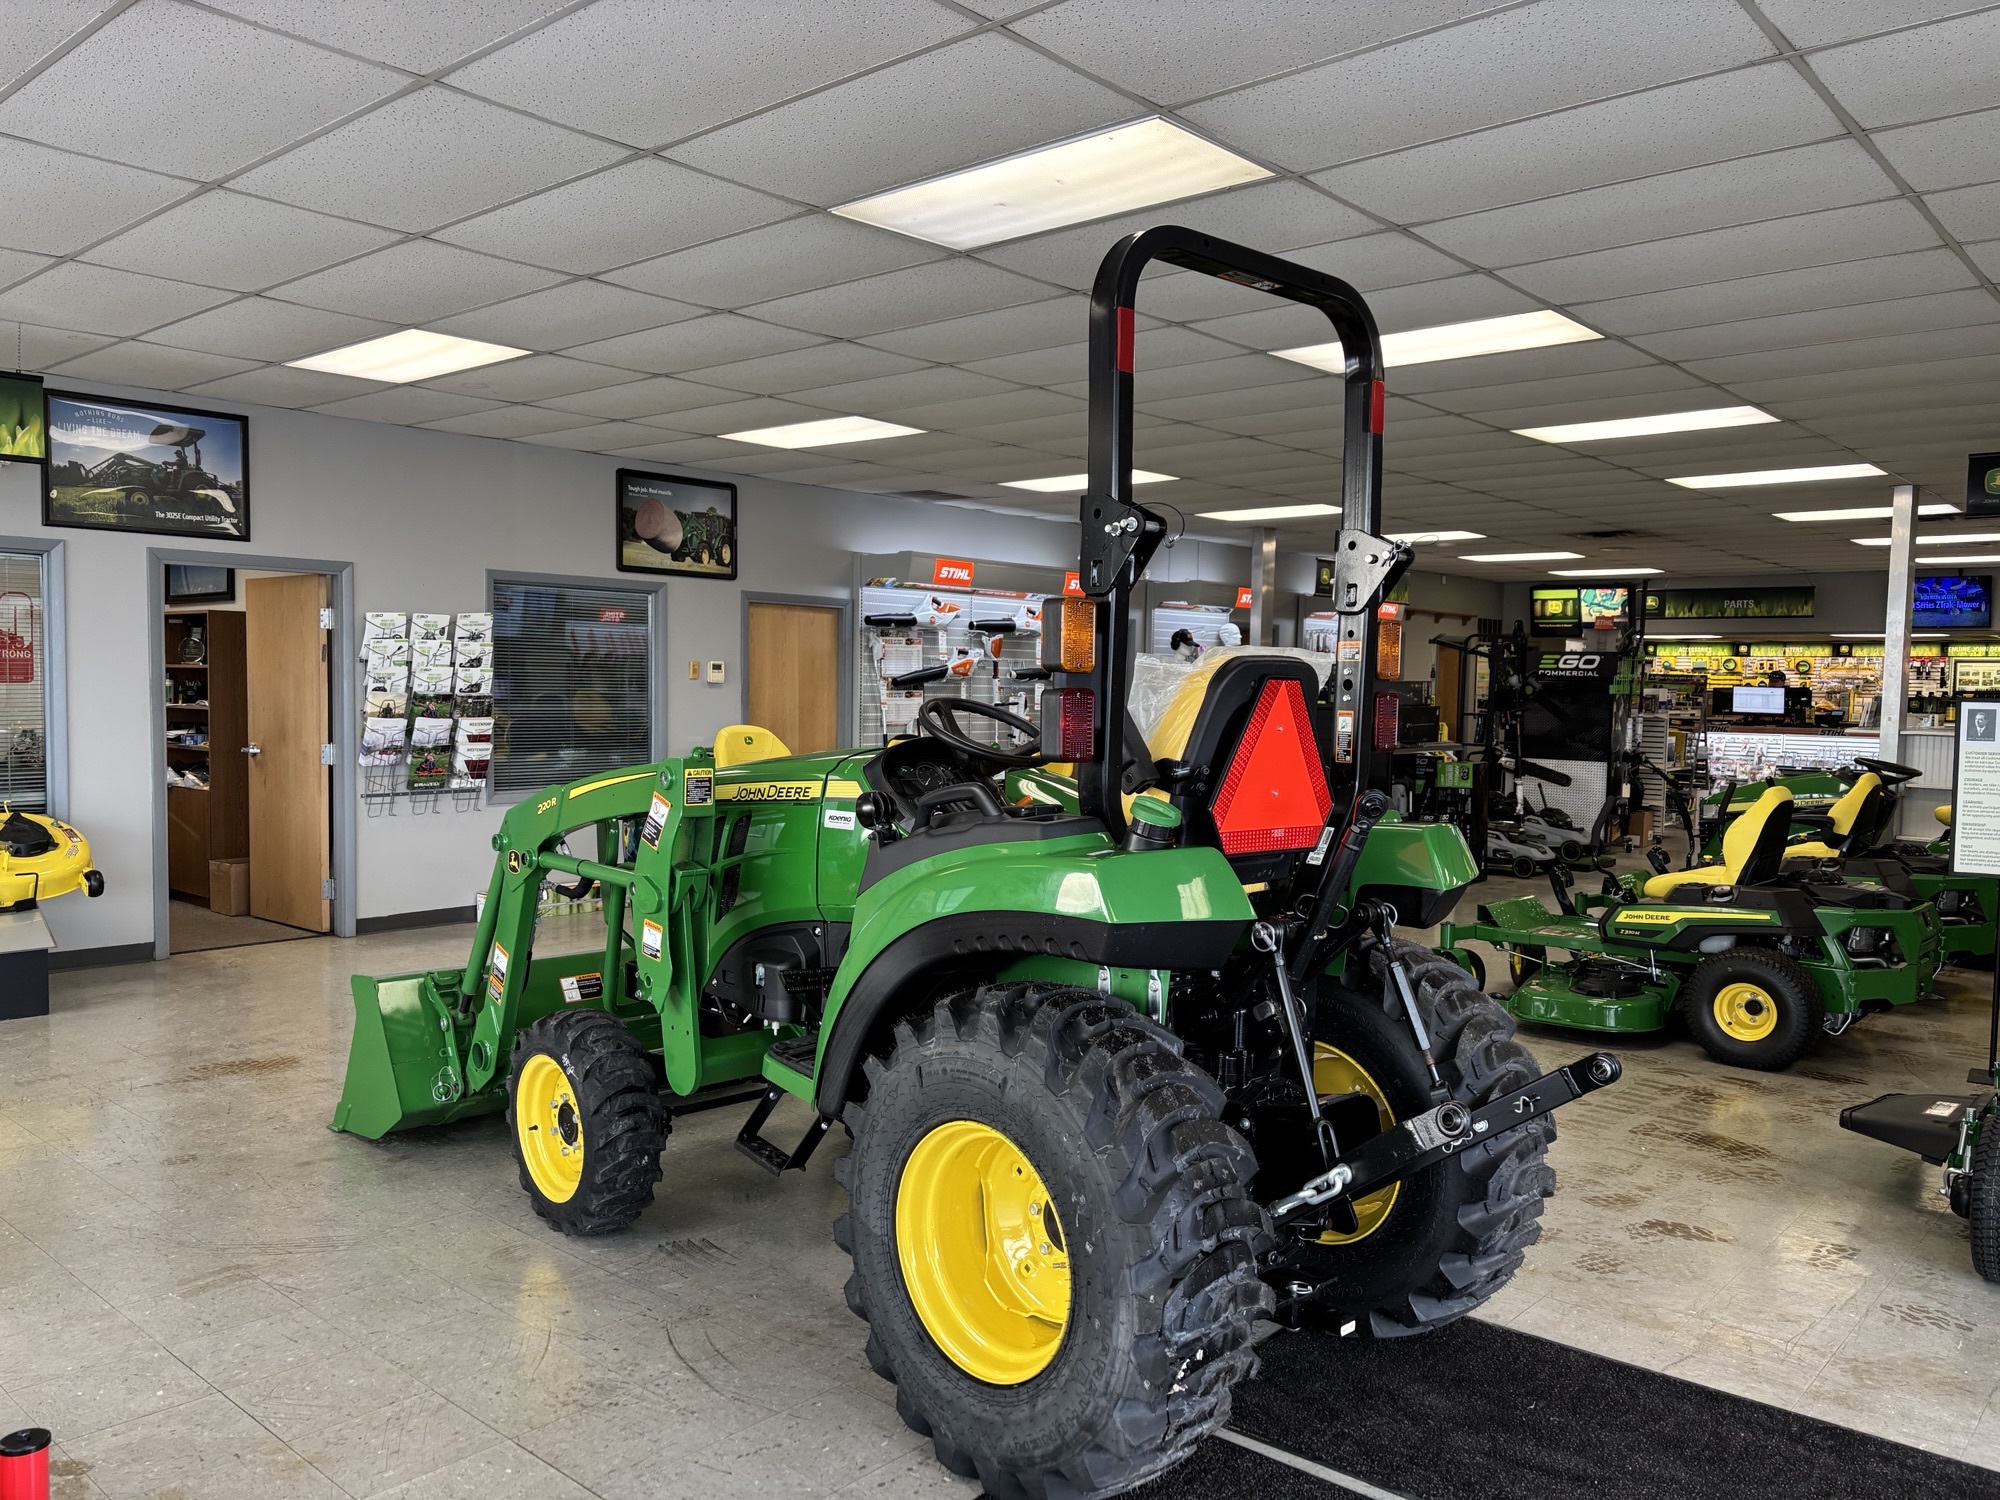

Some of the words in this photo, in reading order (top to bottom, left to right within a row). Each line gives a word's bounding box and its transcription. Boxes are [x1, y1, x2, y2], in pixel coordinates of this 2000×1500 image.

[75, 409, 105, 418] NOTHING
[108, 412, 125, 423] RUNS
[57, 422, 88, 435] LIVING
[91, 425, 108, 437] THE
[111, 428, 140, 440] DREAM
[628, 484, 640, 493] Tough
[155, 511, 165, 519] The
[166, 512, 182, 520] 3025E
[182, 513, 205, 522] Compact
[205, 515, 220, 524] Utility
[221, 516, 239, 524] Tractor
[939, 567, 971, 580] STIHL
[1381, 604, 1397, 613] STIHL
[1724, 599, 1755, 608] PARTS
[1956, 601, 1979, 609] Mower
[1538, 655, 1601, 669] EGO
[732, 786, 767, 802] JOHN
[767, 784, 813, 800] DEERE
[537, 796, 557, 816] 220R
[1623, 913, 1645, 921] JOHN
[1645, 913, 1671, 921] DEERE
